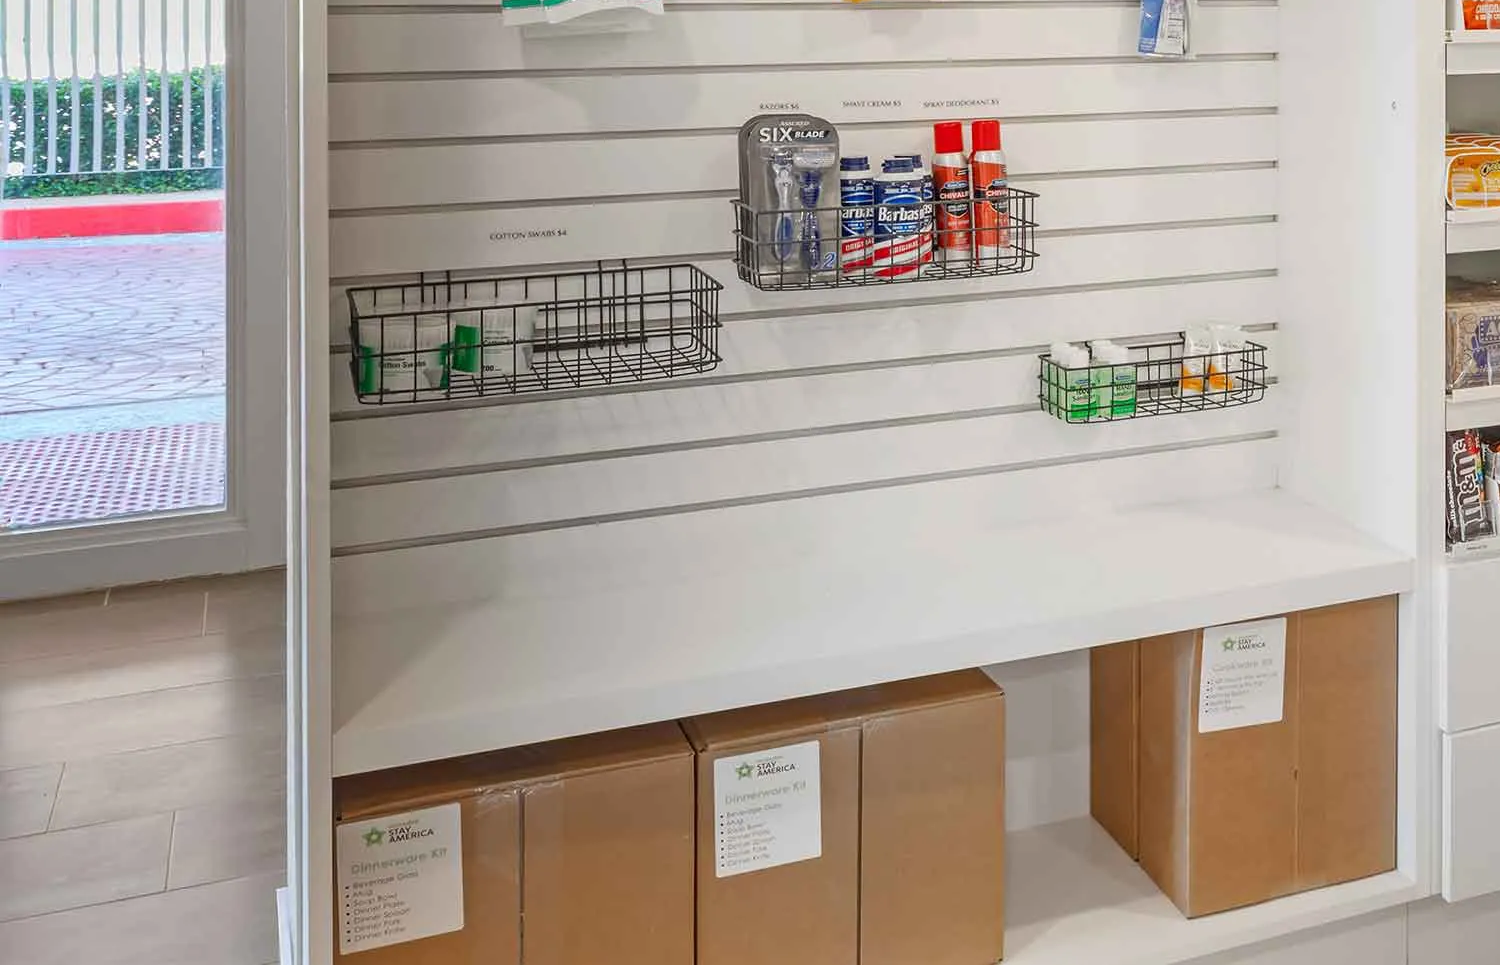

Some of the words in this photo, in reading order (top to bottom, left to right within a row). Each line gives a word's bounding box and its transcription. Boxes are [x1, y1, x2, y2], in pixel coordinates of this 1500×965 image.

[760, 127, 793, 142] SIX
[794, 130, 825, 138] BLADE
[878, 206, 920, 222] Barbas
[757, 761, 777, 771] STAY
[757, 763, 796, 777] AMERICA
[388, 826, 412, 836] STAY
[389, 828, 434, 844] AMERICA
[351, 853, 427, 875] Dinnerware
[431, 847, 447, 860] Kit
